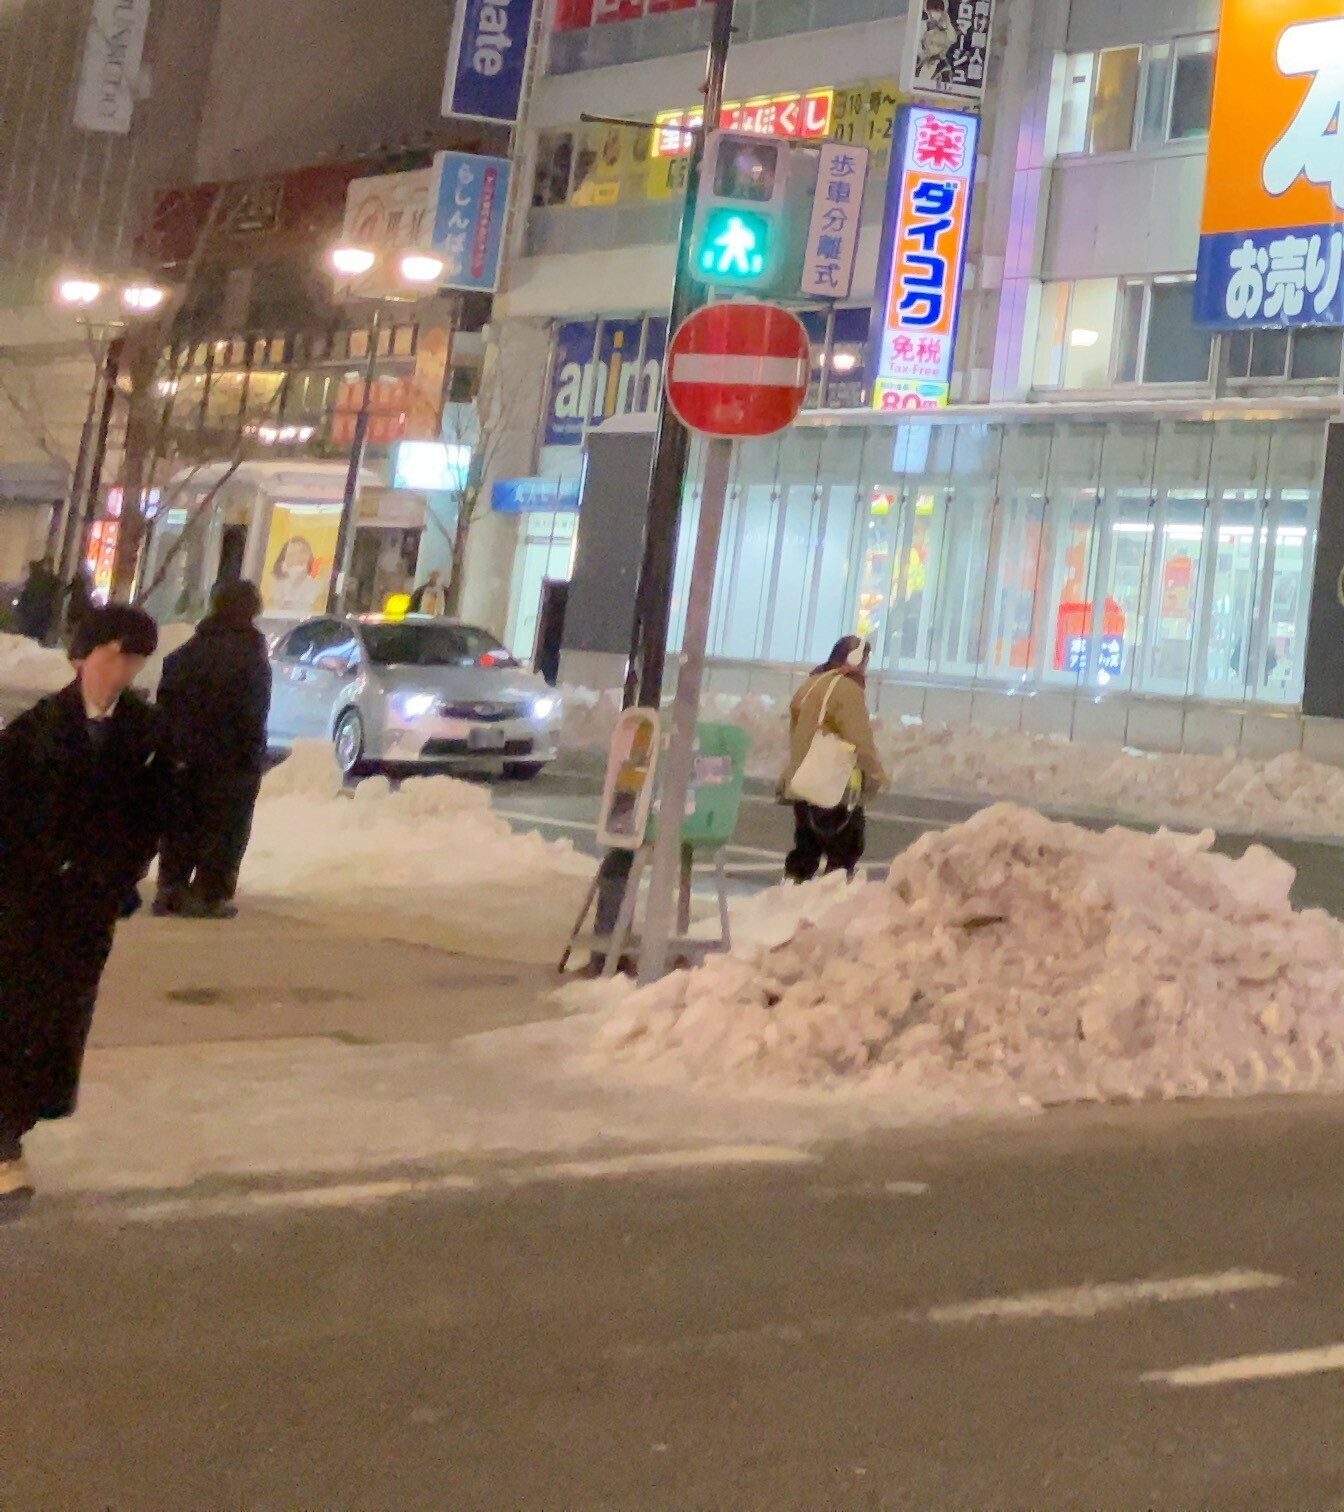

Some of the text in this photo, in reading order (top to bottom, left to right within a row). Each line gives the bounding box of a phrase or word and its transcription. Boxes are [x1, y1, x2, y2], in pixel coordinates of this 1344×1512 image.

[915, 115, 967, 169] 薬
[814, 155, 855, 288] 歩車分離式
[900, 181, 959, 325] ダイコク
[891, 336, 942, 364] 免税
